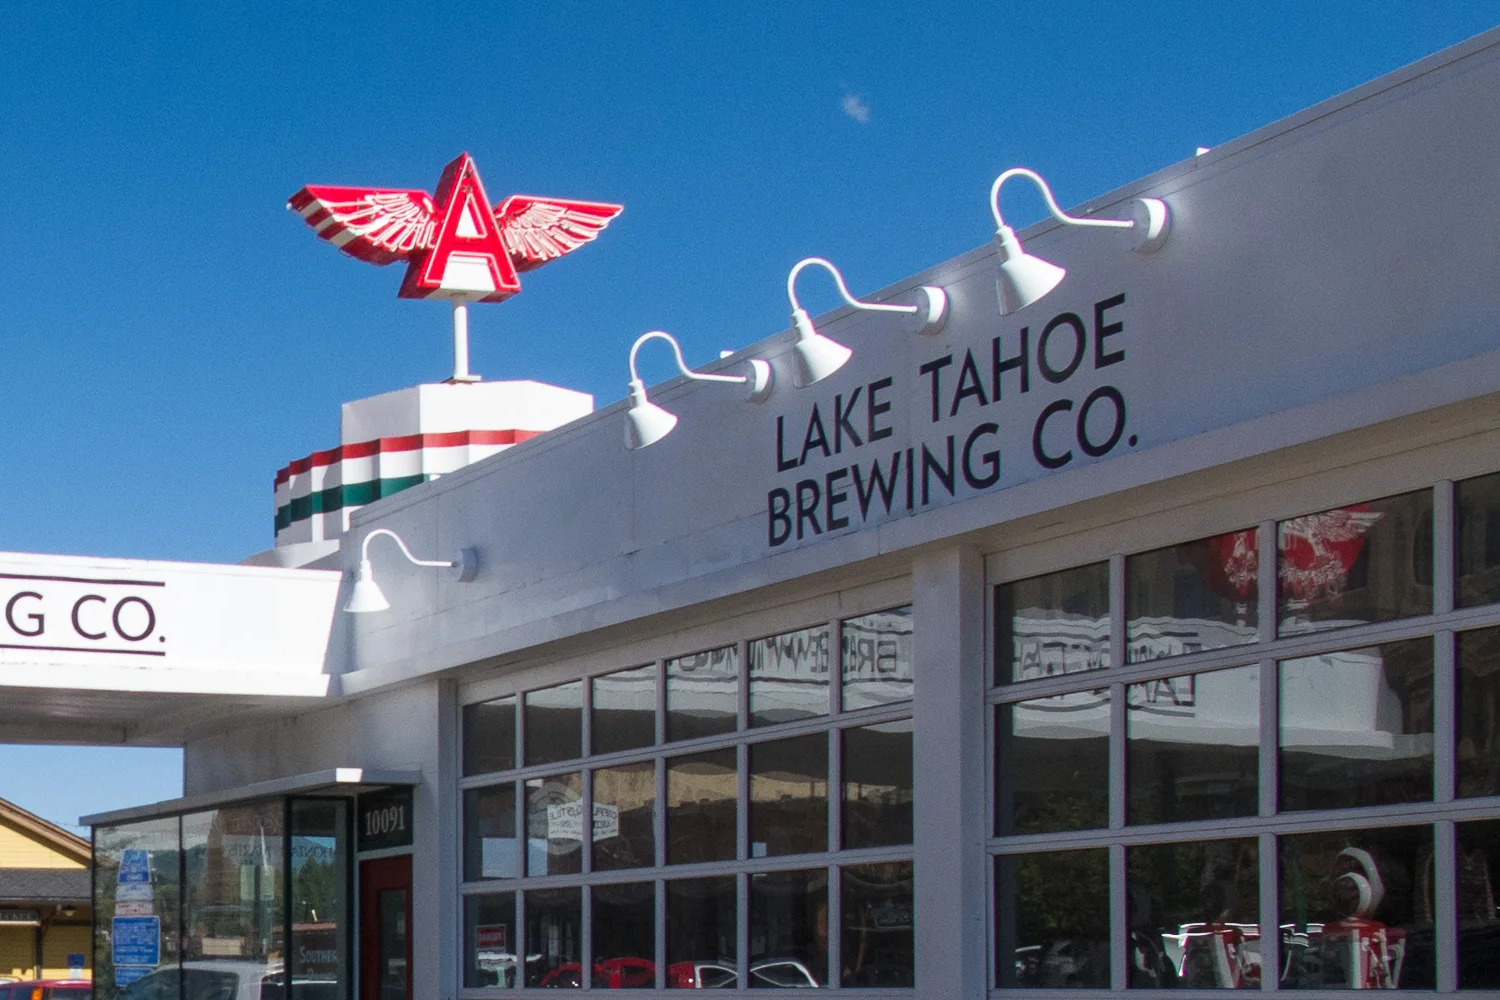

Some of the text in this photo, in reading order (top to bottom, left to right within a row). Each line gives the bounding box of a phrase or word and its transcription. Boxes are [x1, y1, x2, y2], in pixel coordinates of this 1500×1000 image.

[776, 292, 1126, 473] LAKE TAHOE
[767, 385, 1139, 548] BREWING CO.
[71, 593, 167, 644] CO.
[365, 805, 405, 836] 10091
